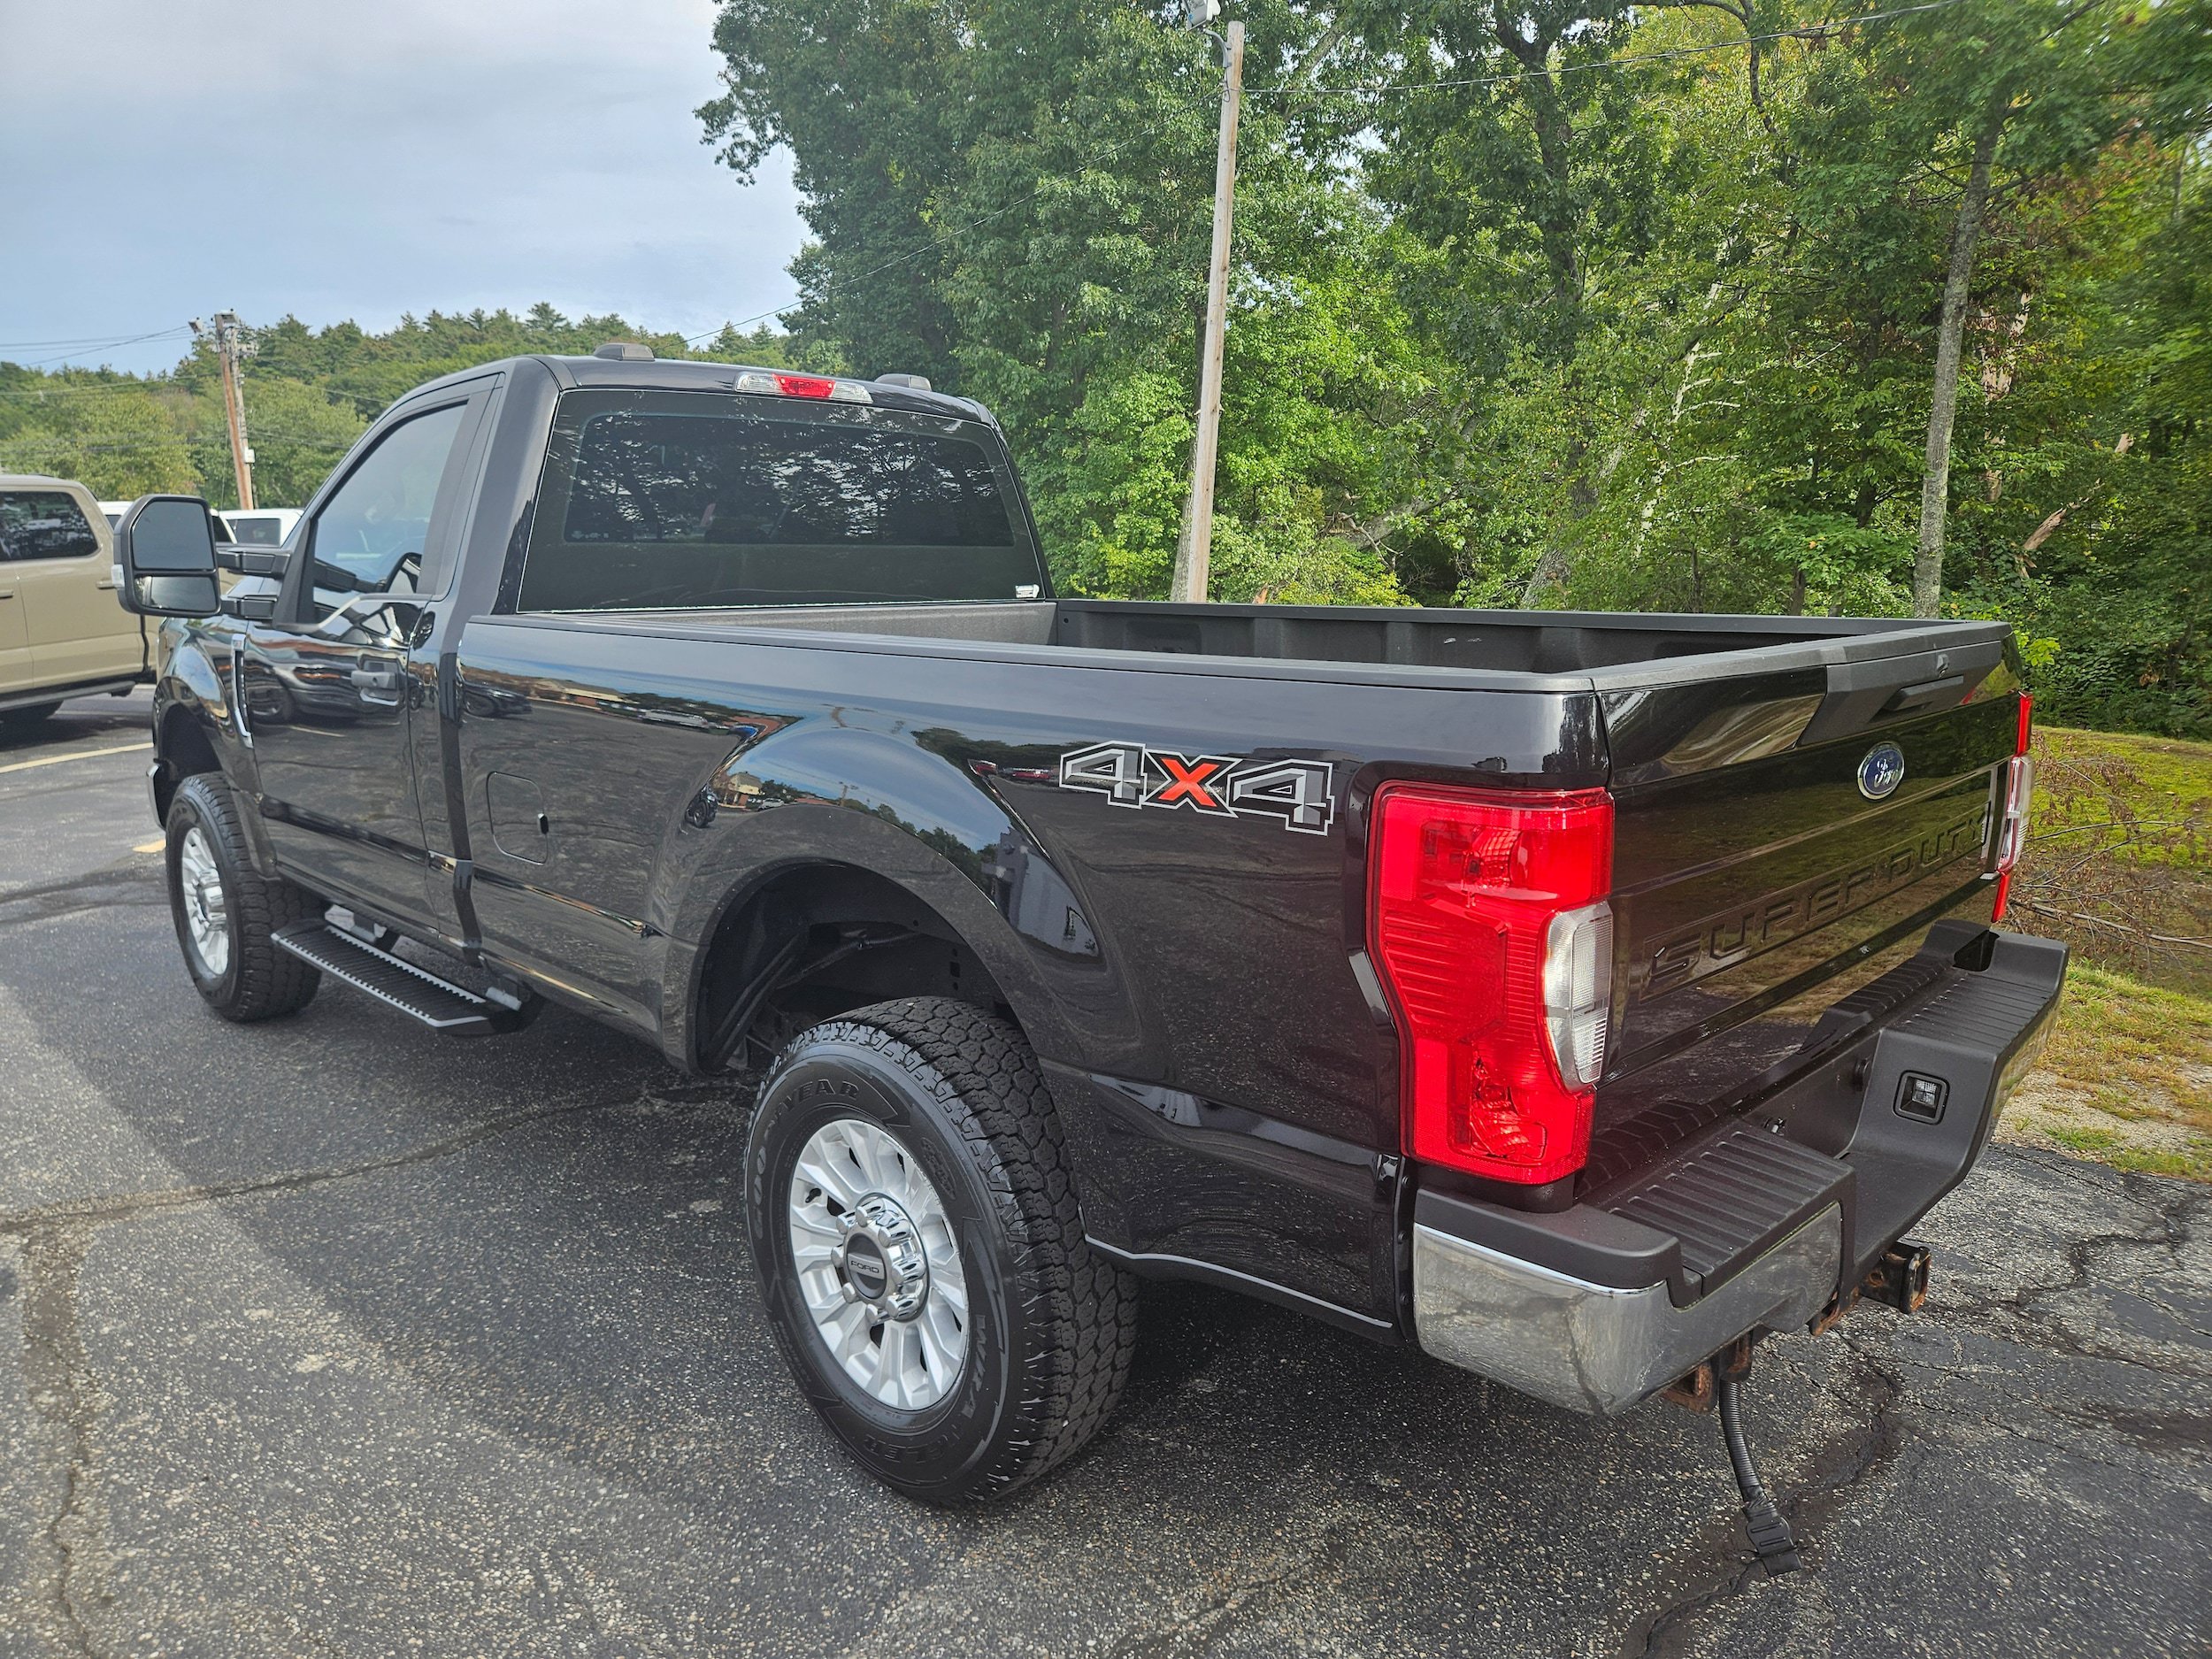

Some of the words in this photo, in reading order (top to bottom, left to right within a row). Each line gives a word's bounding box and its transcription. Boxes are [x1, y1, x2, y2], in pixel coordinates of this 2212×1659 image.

[1649, 863, 1876, 981] SUPER
[1888, 810, 1987, 883] DUTY
[850, 1260, 879, 1274] FORD
